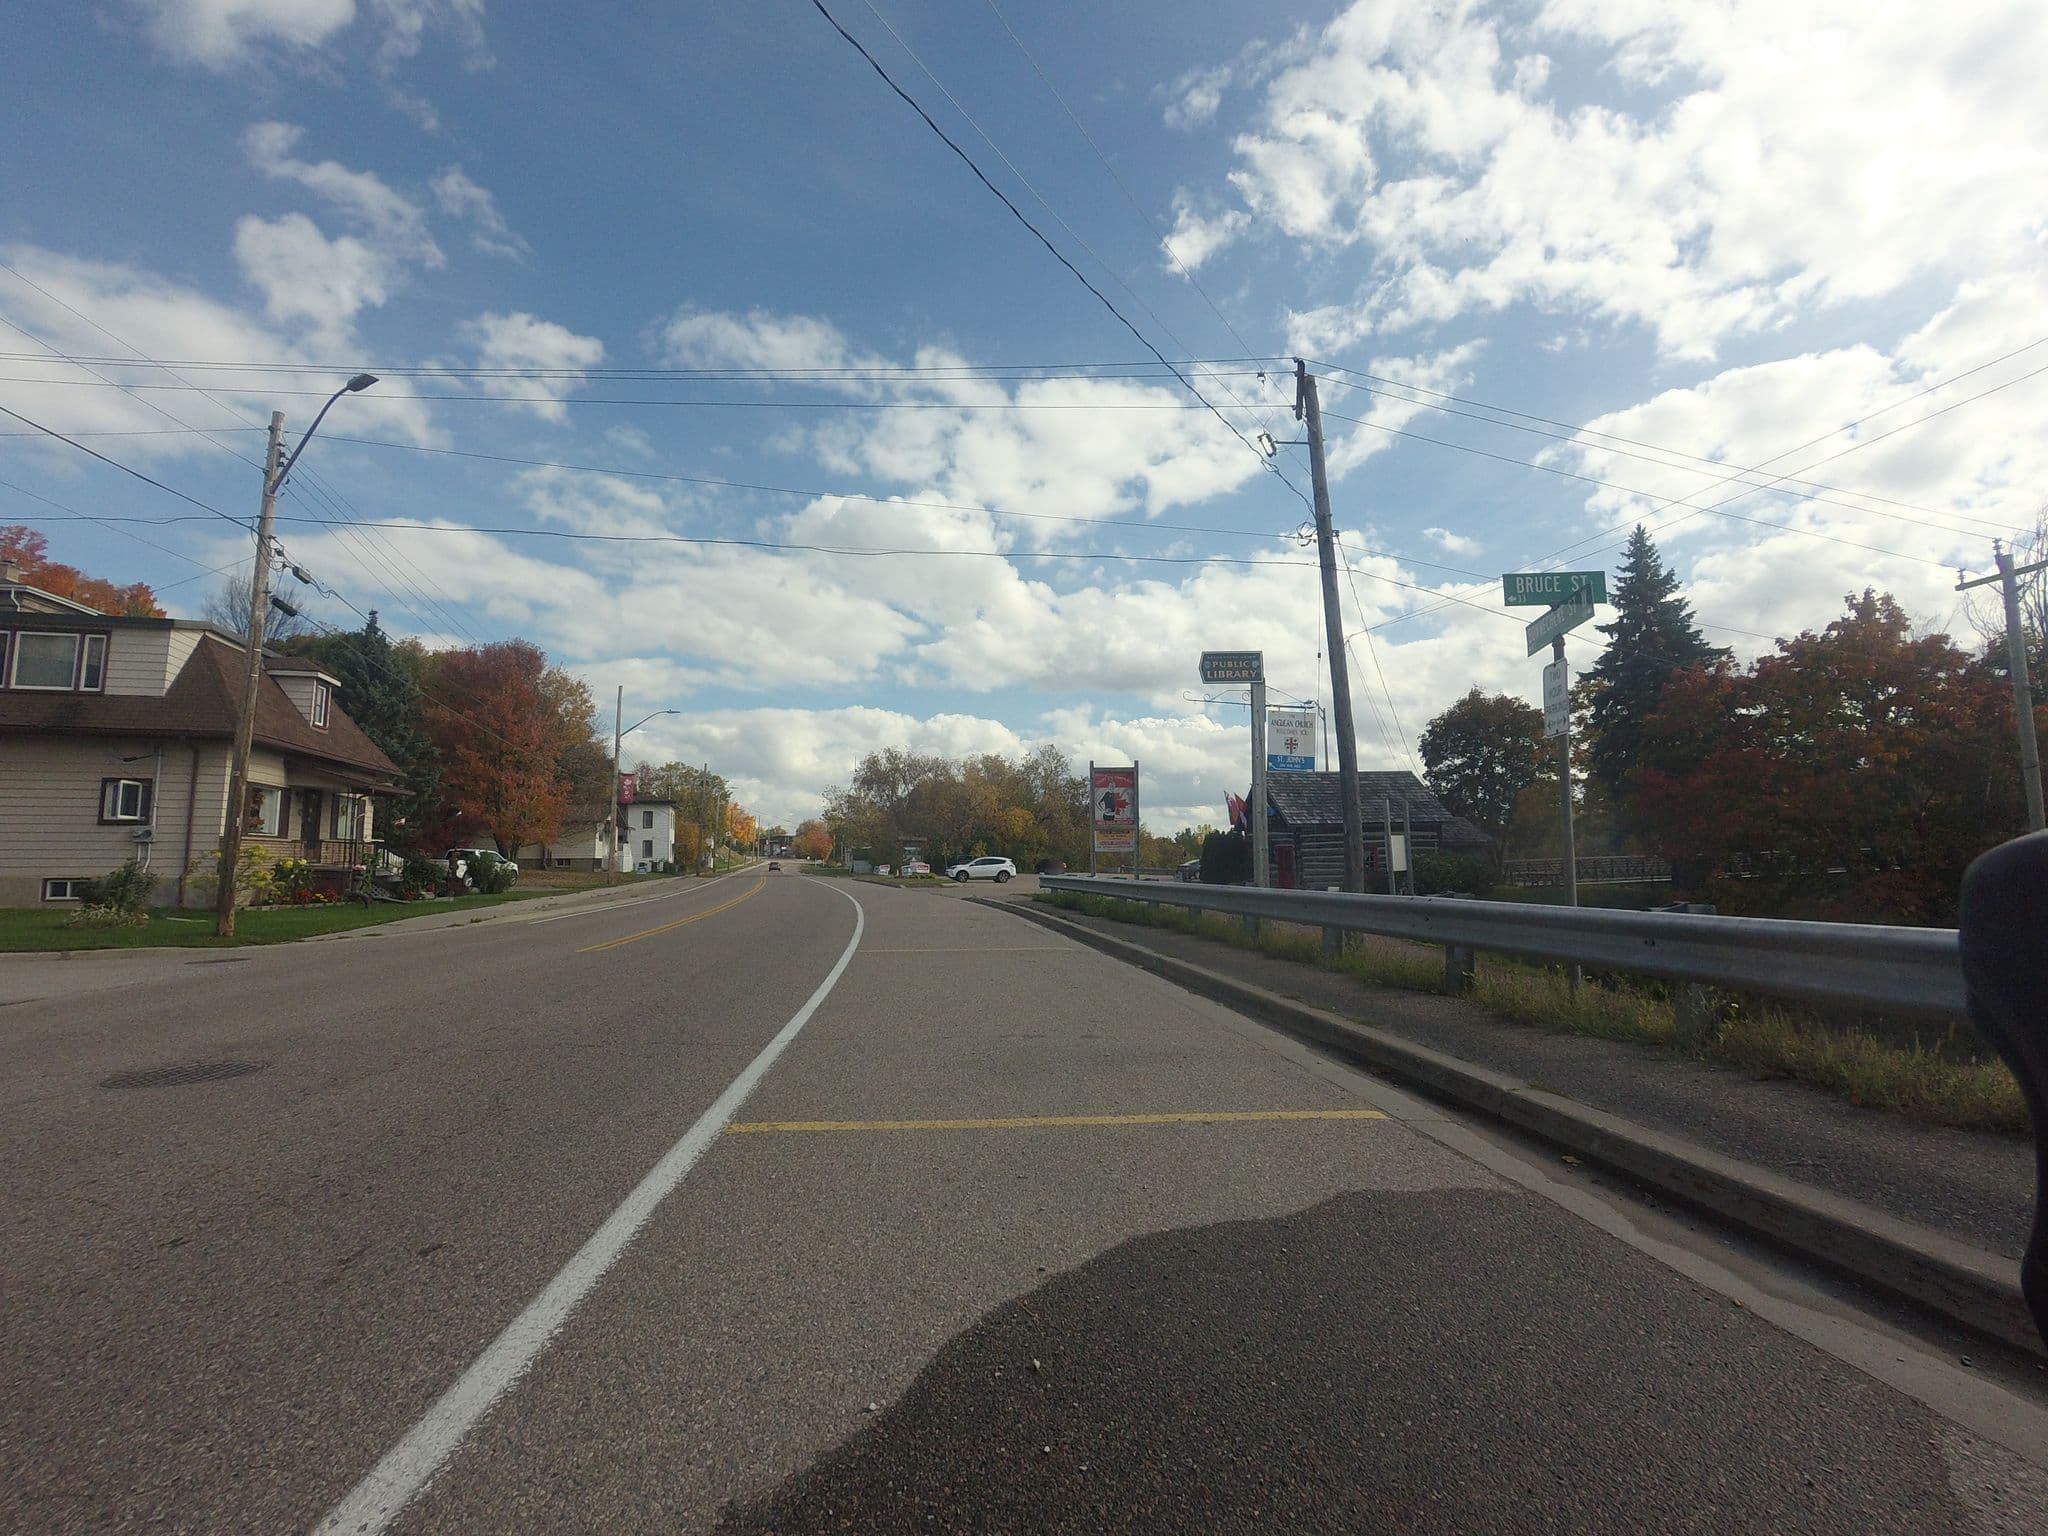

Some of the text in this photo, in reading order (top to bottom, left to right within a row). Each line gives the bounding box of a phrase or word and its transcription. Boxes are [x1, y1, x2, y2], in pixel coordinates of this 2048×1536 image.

[1516, 575, 1588, 593] BRUCE ST
[1212, 660, 1250, 668] PUBLIC
[1207, 670, 1257, 679] LIBRARY
